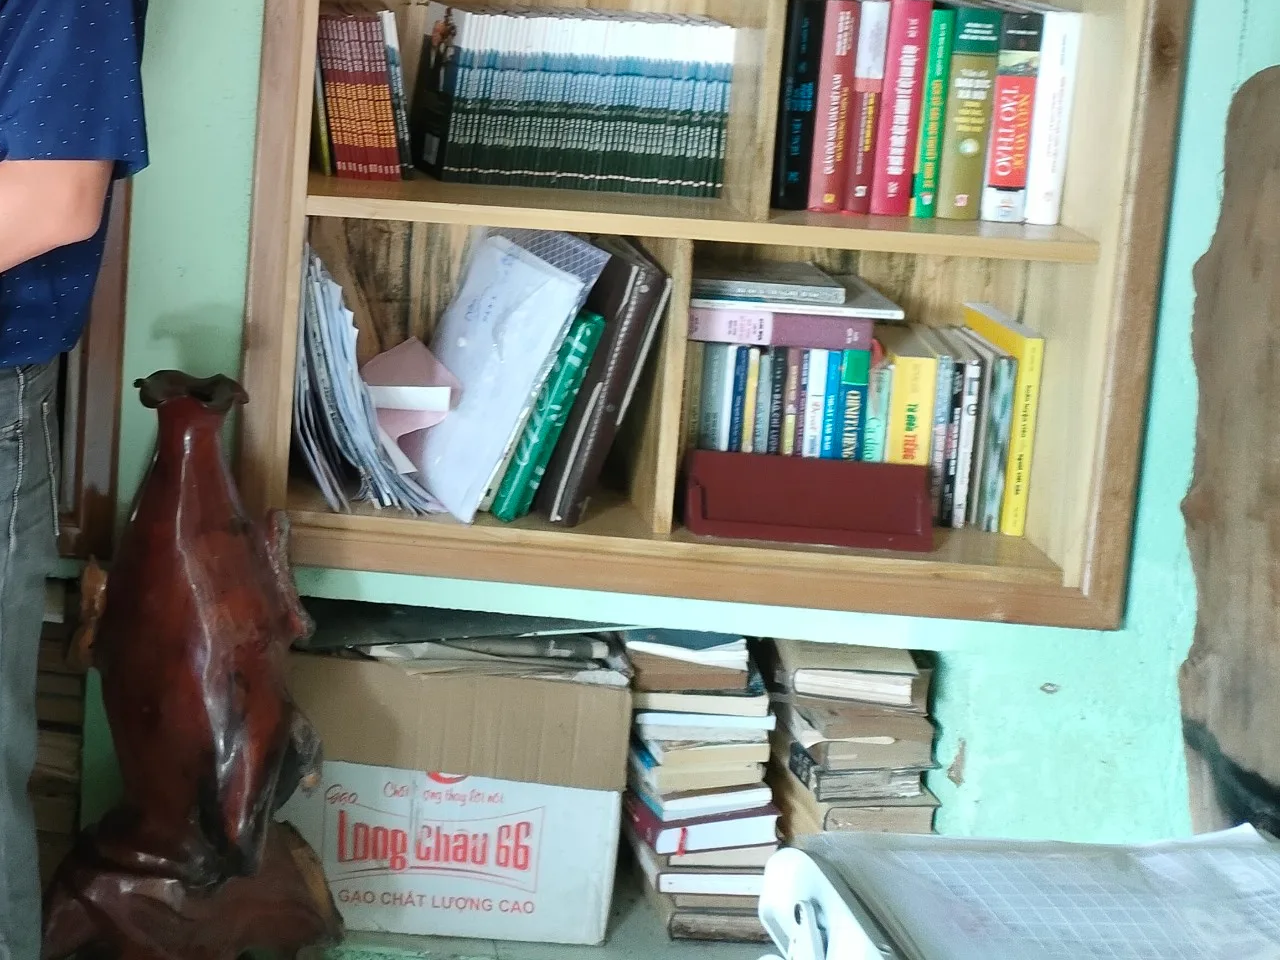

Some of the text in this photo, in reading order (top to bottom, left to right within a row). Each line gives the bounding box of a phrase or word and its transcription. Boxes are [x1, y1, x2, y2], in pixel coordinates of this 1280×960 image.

[336, 809, 408, 872] Long
[495, 820, 533, 872] 66
[337, 887, 536, 914] GẠO CHẤT LƯỢNG CAO
